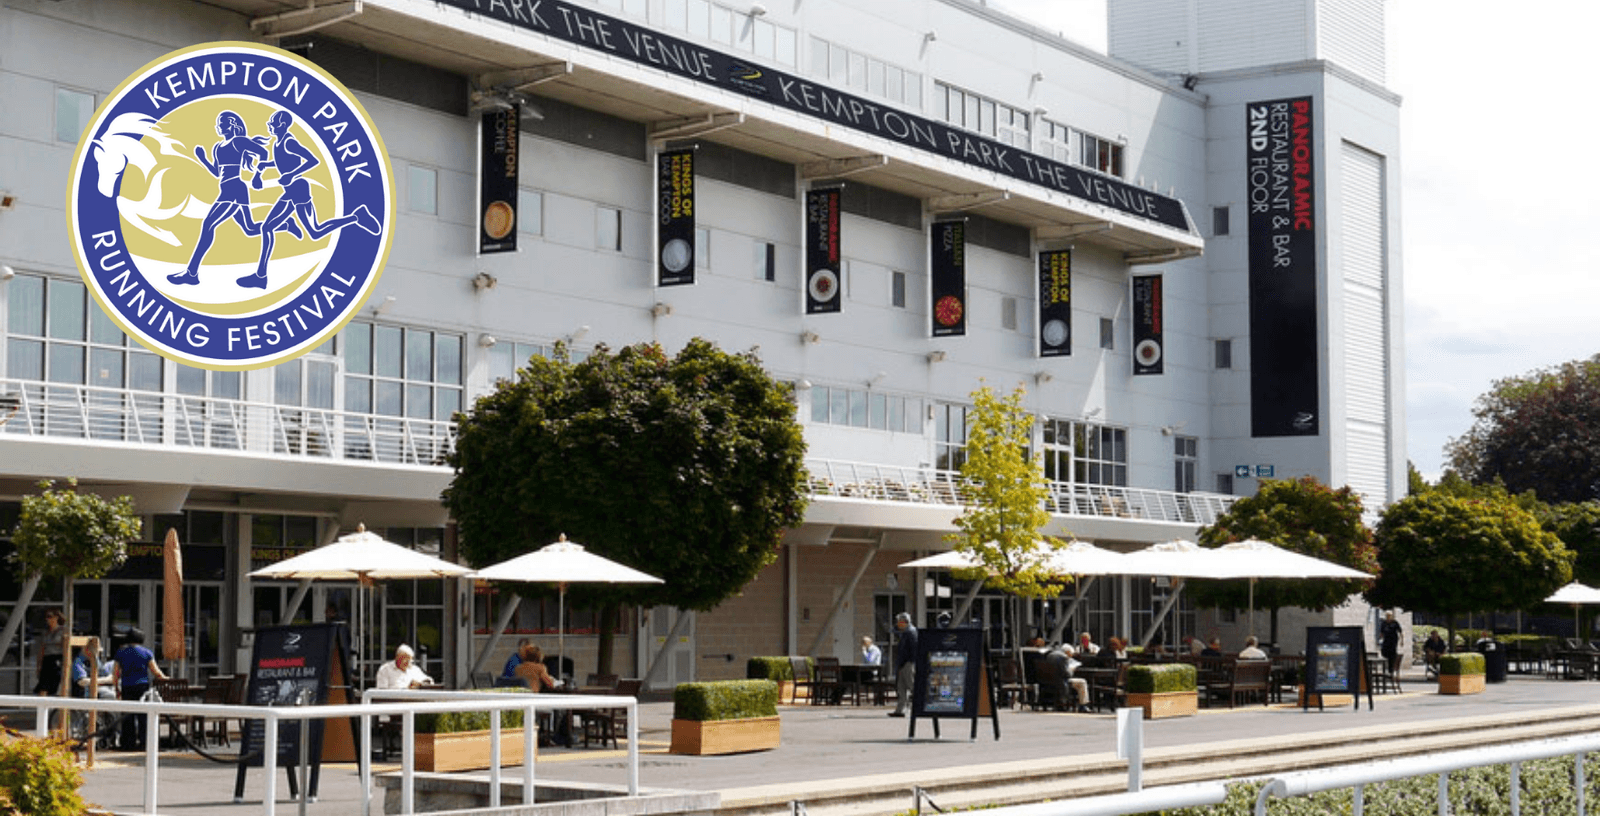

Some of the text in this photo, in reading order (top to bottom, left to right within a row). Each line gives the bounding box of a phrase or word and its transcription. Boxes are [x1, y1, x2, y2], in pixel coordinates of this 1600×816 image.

[557, 6, 616, 50] THE
[622, 27, 716, 80] VENUE
[505, 108, 517, 178] KEMPTON
[671, 155, 682, 218] KEMPTON
[682, 154, 693, 217] KINGS OF
[778, 76, 1159, 218] KEMPTON PARK THE VENUE
[1251, 106, 1269, 214] 2ND FLOOR
[1271, 102, 1291, 268] RESTAURANT & BAR
[1293, 101, 1312, 231] PANORAMIC
